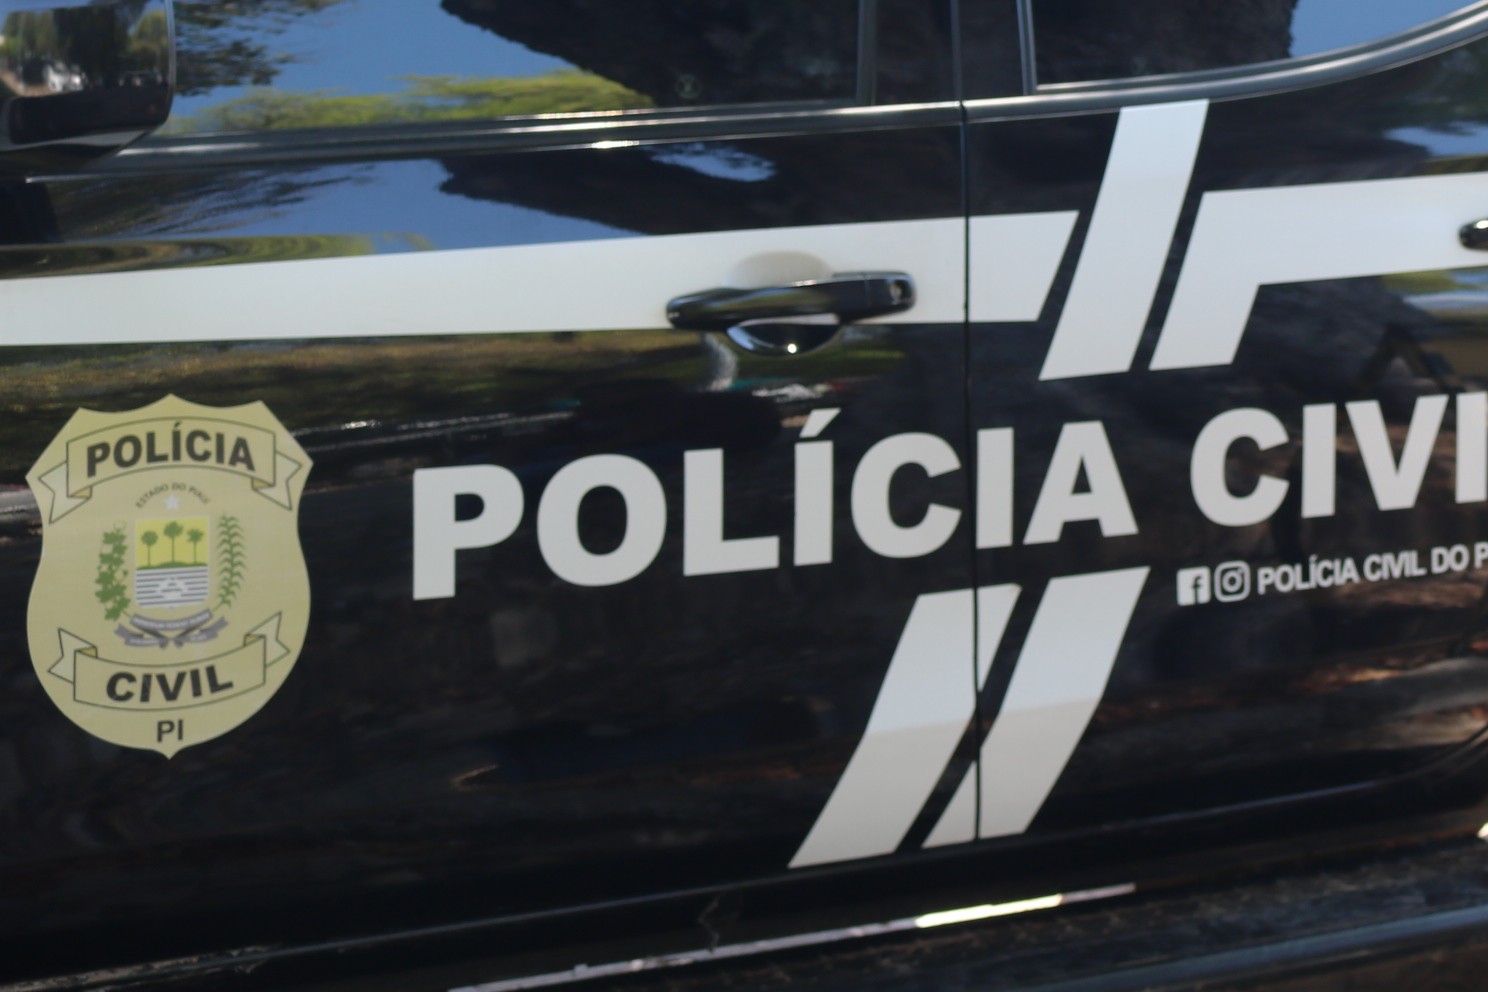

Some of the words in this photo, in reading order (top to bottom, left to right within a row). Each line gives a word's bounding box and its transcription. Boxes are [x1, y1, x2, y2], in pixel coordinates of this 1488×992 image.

[86, 421, 256, 479] POLÍCIA
[413, 408, 1138, 601] POLÍCIA
[1257, 555, 1360, 595] POLÍCIA
[1363, 550, 1427, 582] CIVIL
[1431, 544, 1470, 574] DO
[105, 664, 235, 703] CIVIL
[157, 719, 184, 743] PI
